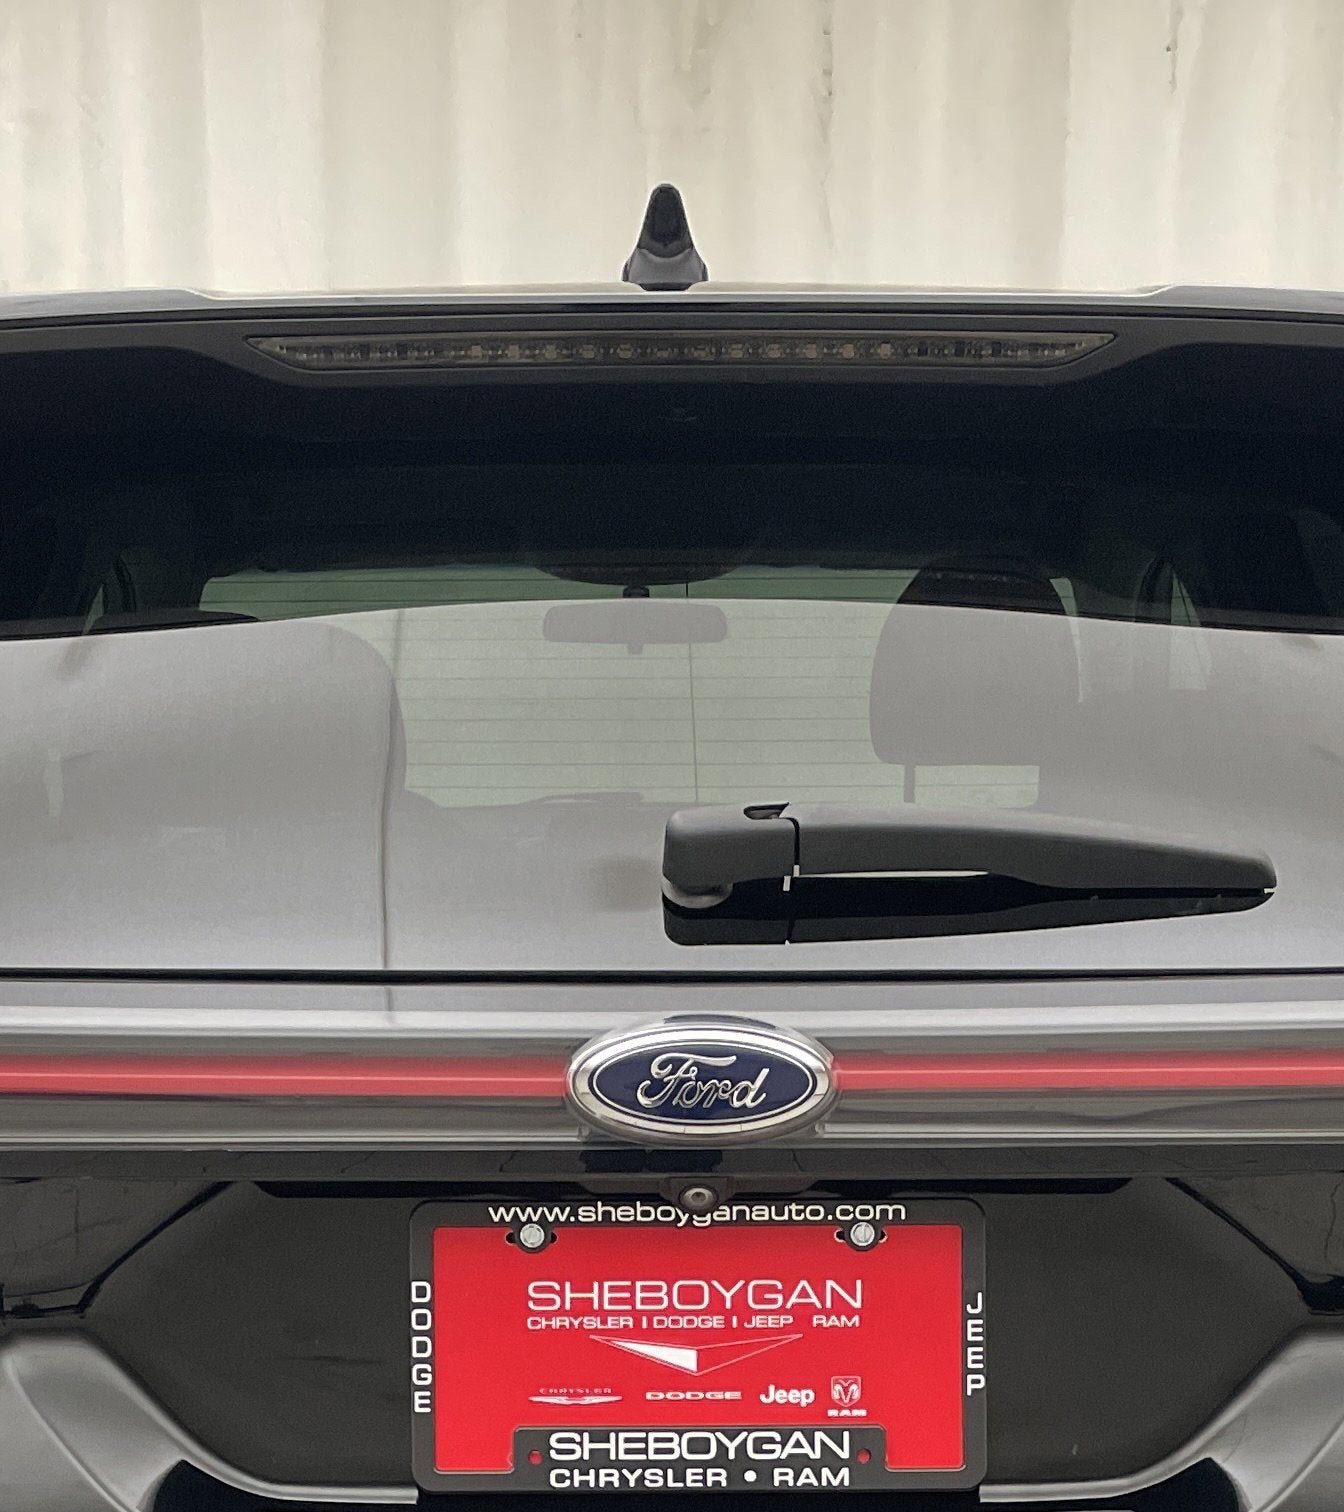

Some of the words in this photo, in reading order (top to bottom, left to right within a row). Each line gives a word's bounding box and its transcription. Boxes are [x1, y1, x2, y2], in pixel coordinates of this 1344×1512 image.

[636, 1052, 770, 1109] Ford
[488, 1200, 906, 1227] www.sheboyganauto.com
[527, 1279, 863, 1311] SHEBOYGAN
[526, 1315, 634, 1330] CHRYSLER
[652, 1314, 726, 1330] DODGE
[743, 1314, 794, 1329] JEEP
[812, 1314, 860, 1328] RAM
[410, 1280, 433, 1413] DODGE
[966, 1291, 986, 1397] JEEP
[645, 1391, 743, 1401] DODGE
[759, 1384, 816, 1408] Jeep
[827, 1408, 868, 1417] RAM
[549, 1430, 850, 1462] SHEBOYGAN
[549, 1467, 728, 1489] CHRYSLER
[772, 1466, 850, 1488] RAM
